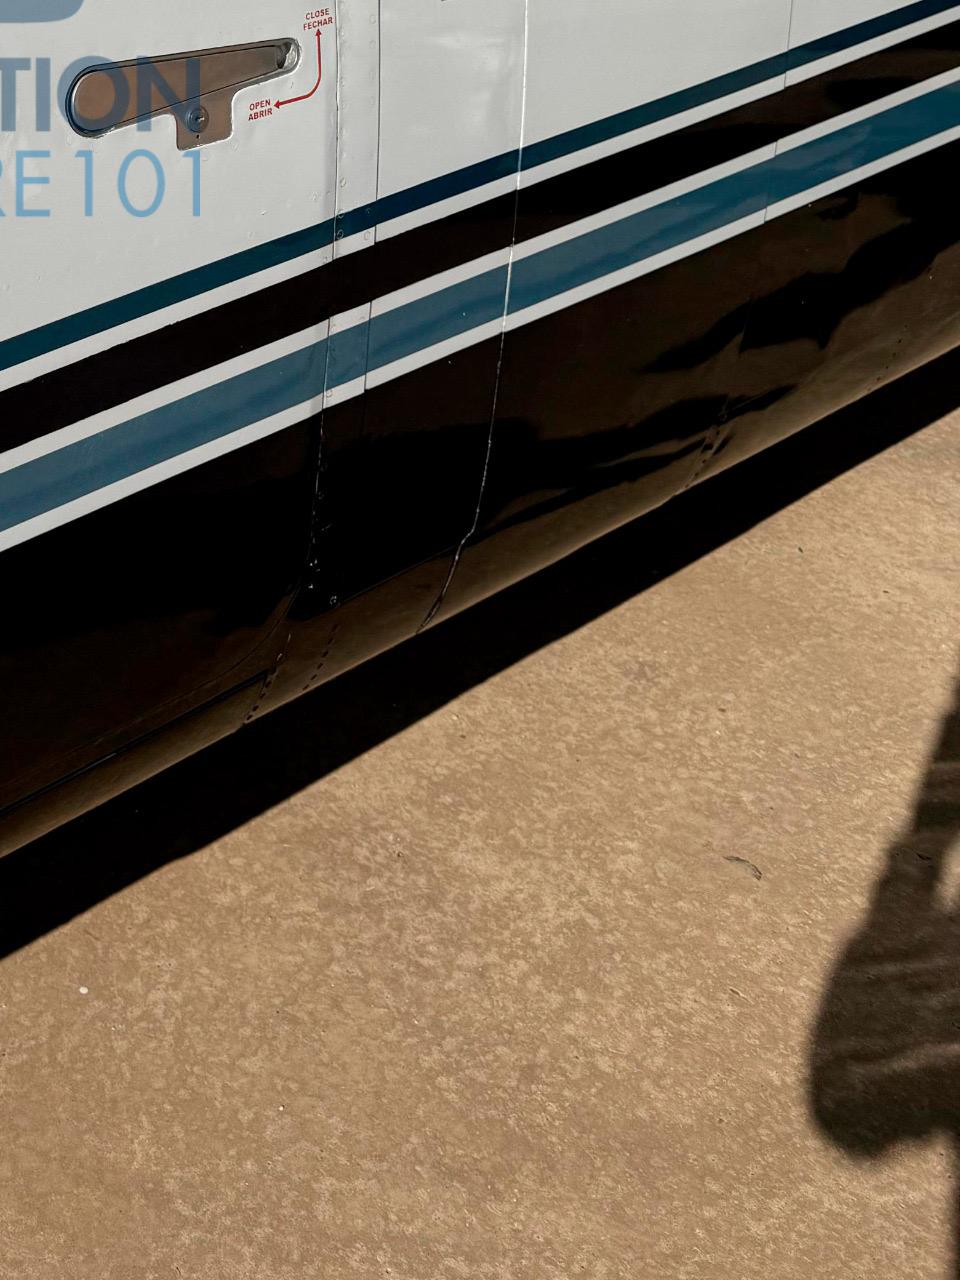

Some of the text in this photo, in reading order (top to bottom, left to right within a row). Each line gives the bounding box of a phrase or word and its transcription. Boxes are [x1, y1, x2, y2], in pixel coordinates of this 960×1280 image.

[305, 8, 330, 20] CLOSE
[303, 16, 333, 30] FECHAR
[249, 99, 271, 111] OPEN
[248, 108, 273, 121] ABRIR
